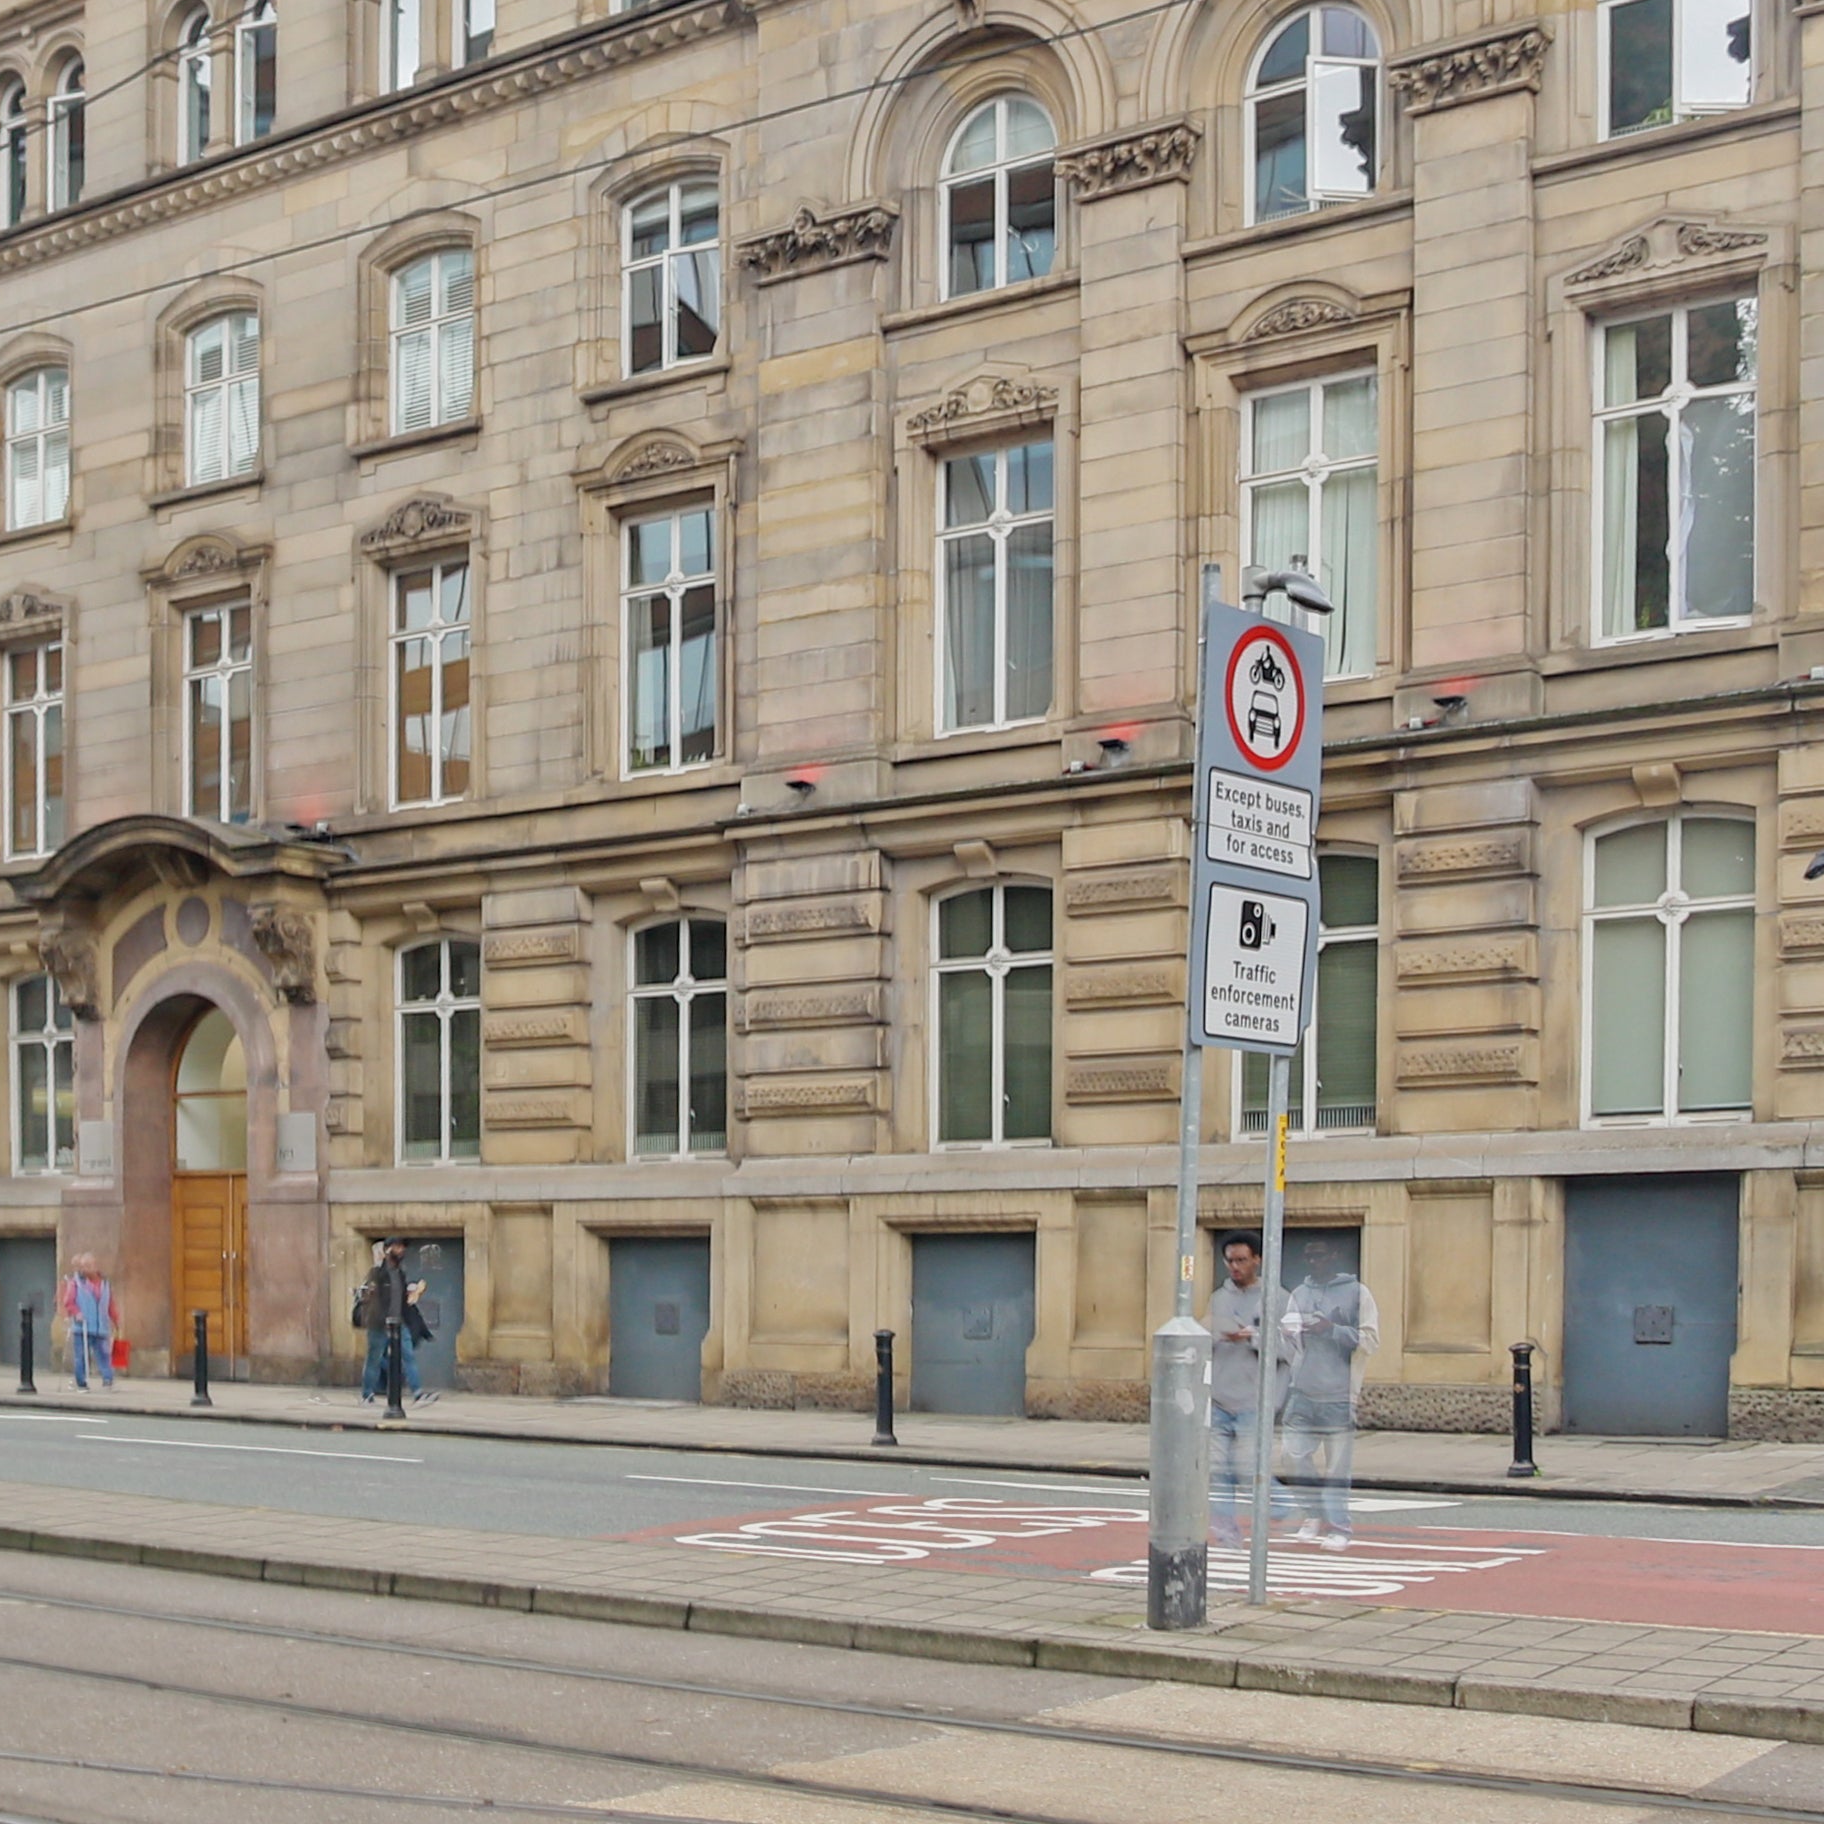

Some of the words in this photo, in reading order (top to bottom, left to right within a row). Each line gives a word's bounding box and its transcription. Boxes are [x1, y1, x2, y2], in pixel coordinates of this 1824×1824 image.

[1216, 781, 1261, 810] Except
[1231, 810, 1263, 833] taxis
[1266, 822, 1290, 839] and
[1226, 833, 1246, 854] for
[1250, 843, 1294, 865] access
[1233, 961, 1277, 984] Traffic
[1211, 984, 1295, 1011] enforcement
[1224, 1012, 1280, 1033] cameras
